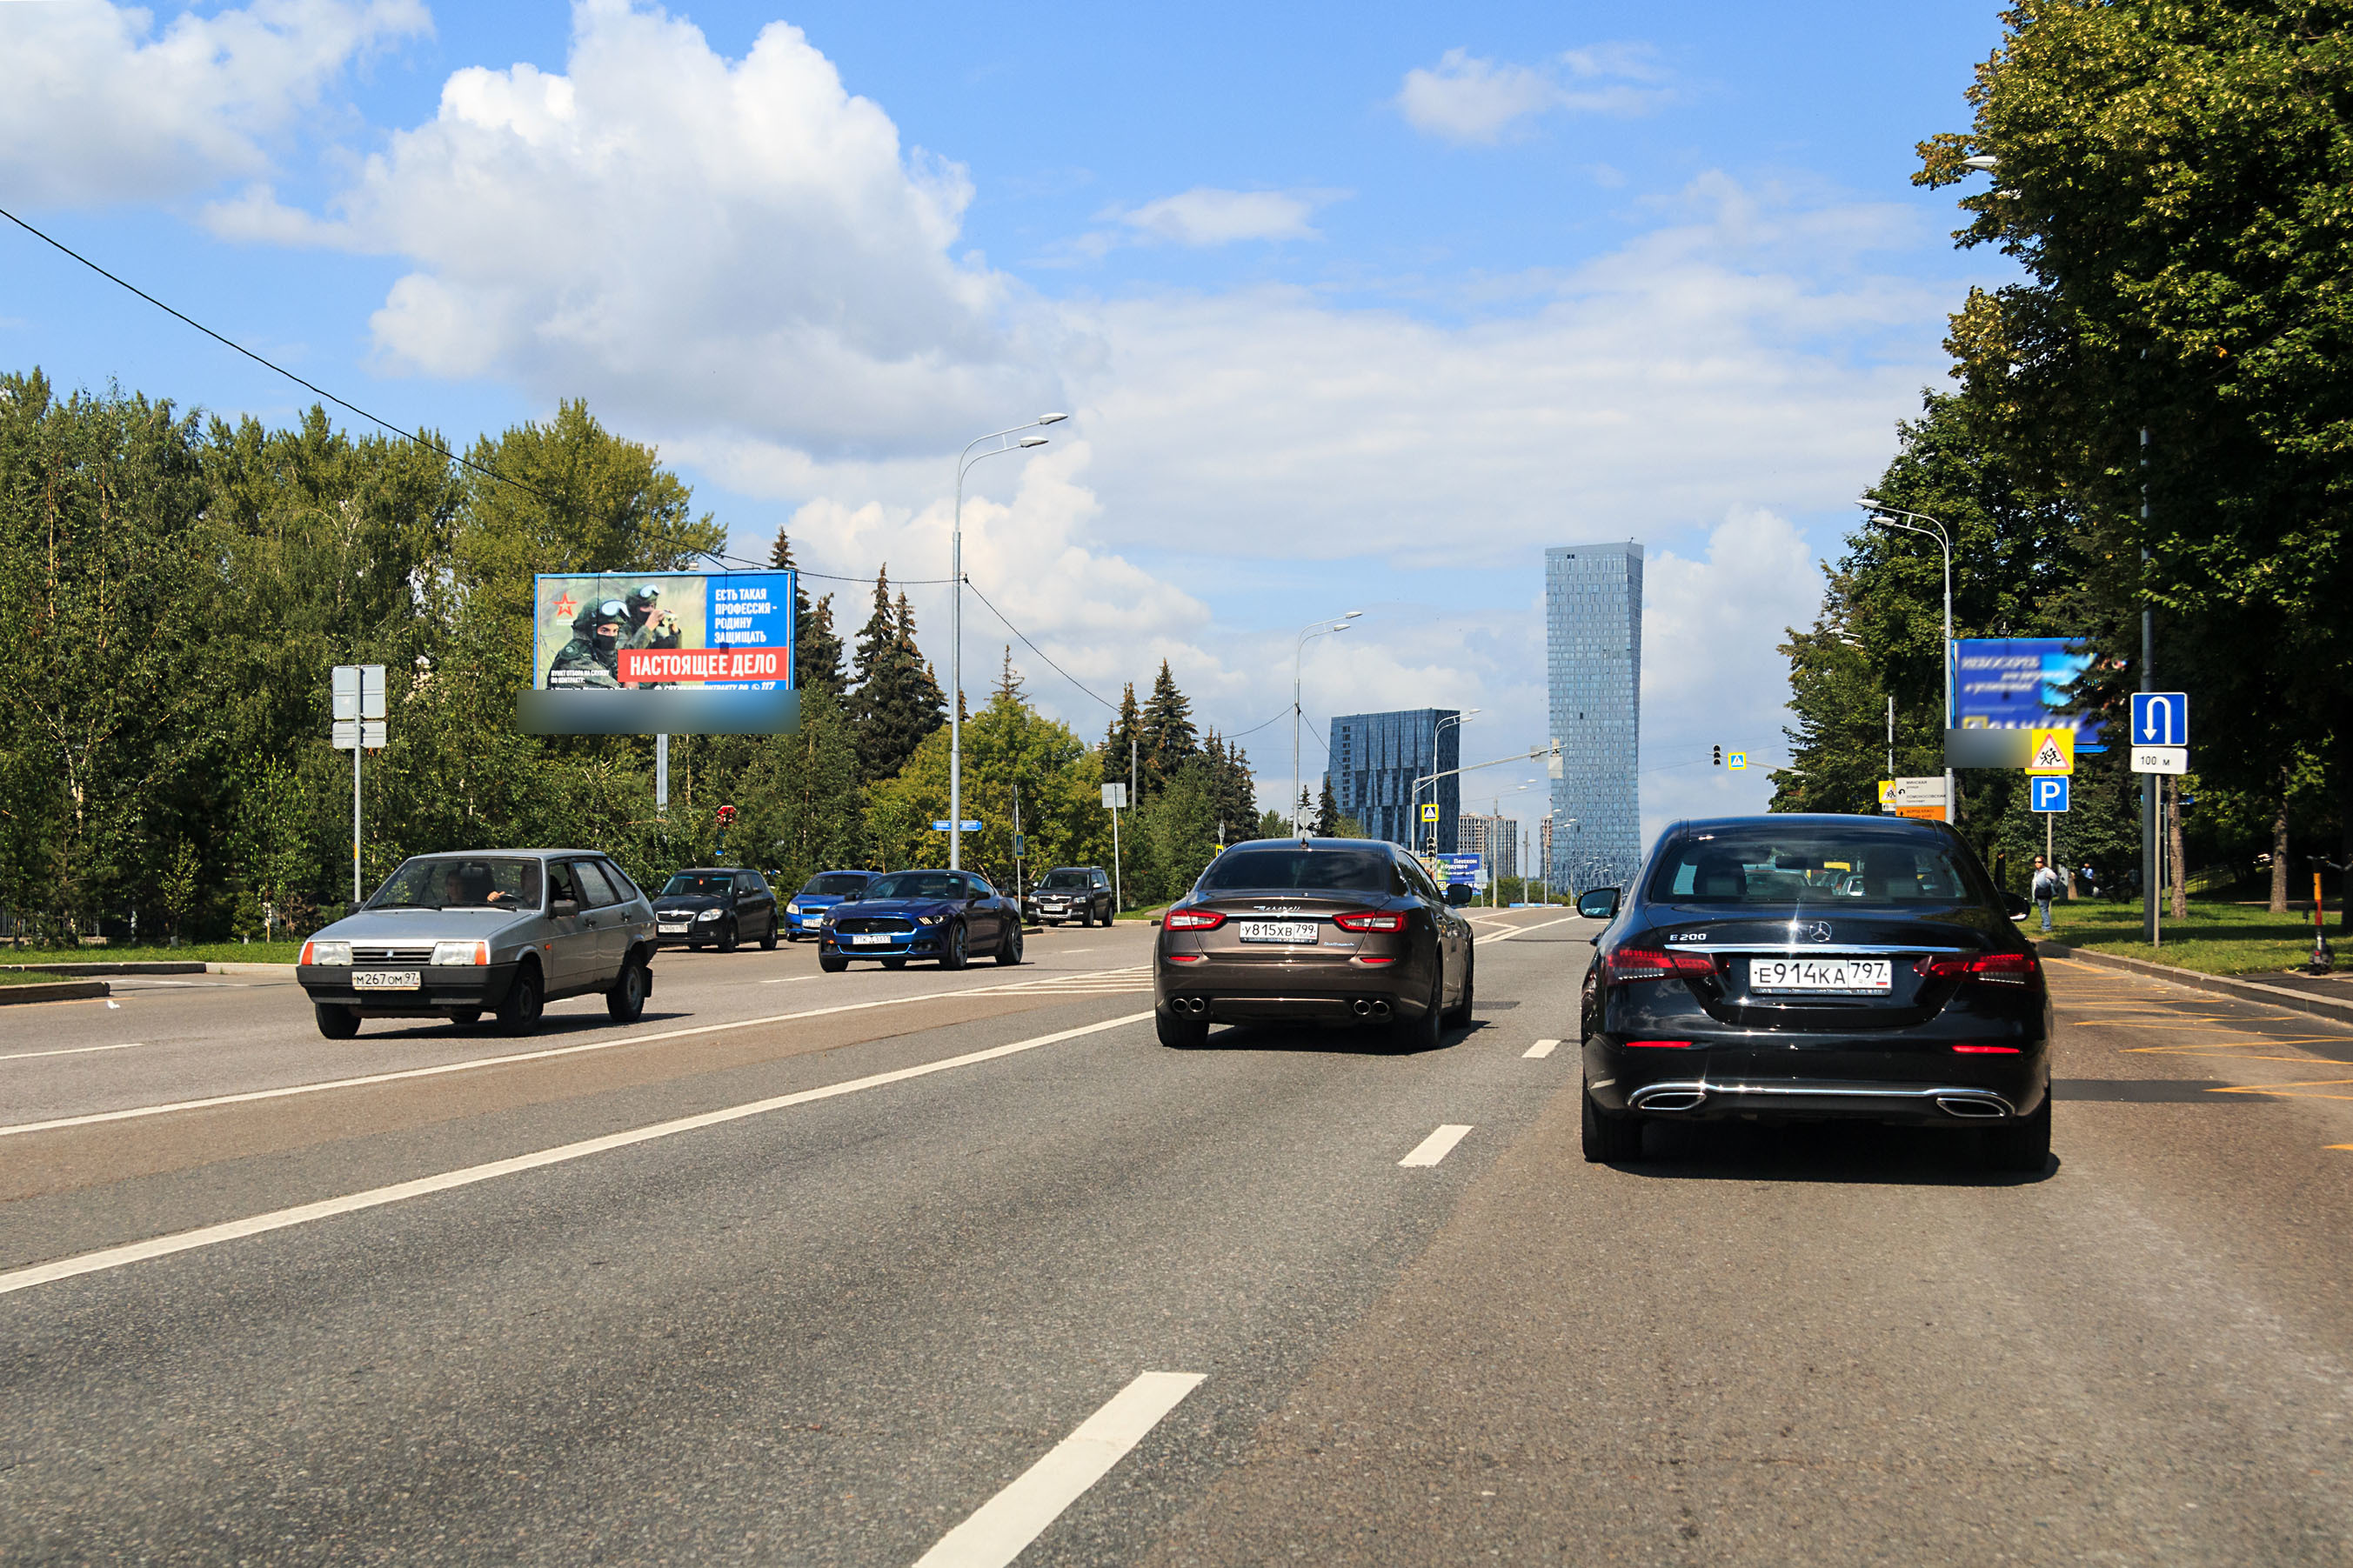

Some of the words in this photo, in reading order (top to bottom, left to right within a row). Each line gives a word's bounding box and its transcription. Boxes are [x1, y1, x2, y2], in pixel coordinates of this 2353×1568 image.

[715, 589, 738, 601] ЕСТЬ
[739, 588, 767, 601] ТАКАЯ
[714, 602, 771, 615] ПРОФЕССИЯ
[714, 617, 752, 630] РОДИНУ
[714, 631, 767, 644] ЗАЩИЩАТЬ
[630, 654, 729, 677] НАСТОЯЩЕЕ
[731, 653, 776, 677] ДЕЛО
[2141, 756, 2157, 765] 100
[2041, 781, 2061, 808] P
[1295, 924, 1314, 934] 799
[404, 972, 417, 982] 97
[1850, 963, 1885, 979] 797
